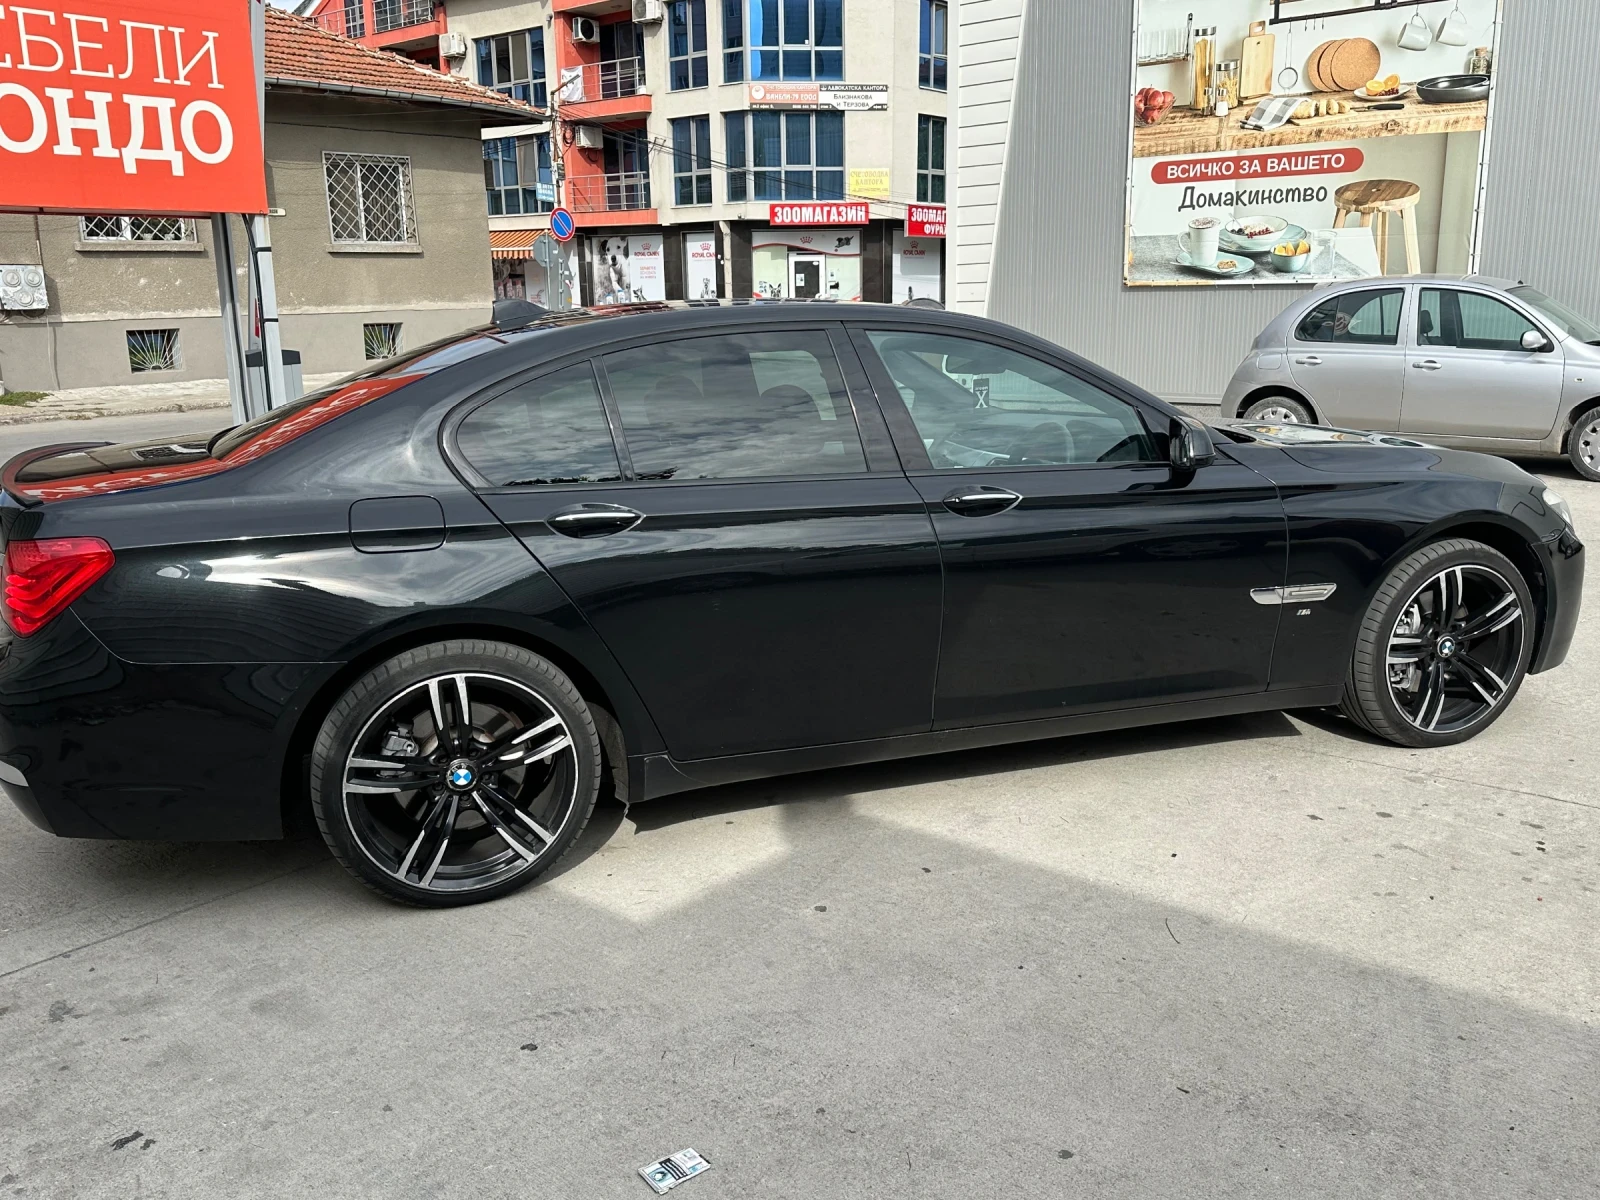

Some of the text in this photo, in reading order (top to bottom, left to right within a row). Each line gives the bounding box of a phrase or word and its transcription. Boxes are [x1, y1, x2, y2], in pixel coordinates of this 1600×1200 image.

[0, 4, 225, 89] БЕЛИ
[1166, 153, 1346, 179] ВСИЧКО ЗА ВАШЕТО
[1178, 185, 1328, 213] Домакинство
[774, 205, 866, 223] ЗООМАГАЗИН
[975, 390, 989, 409] X
